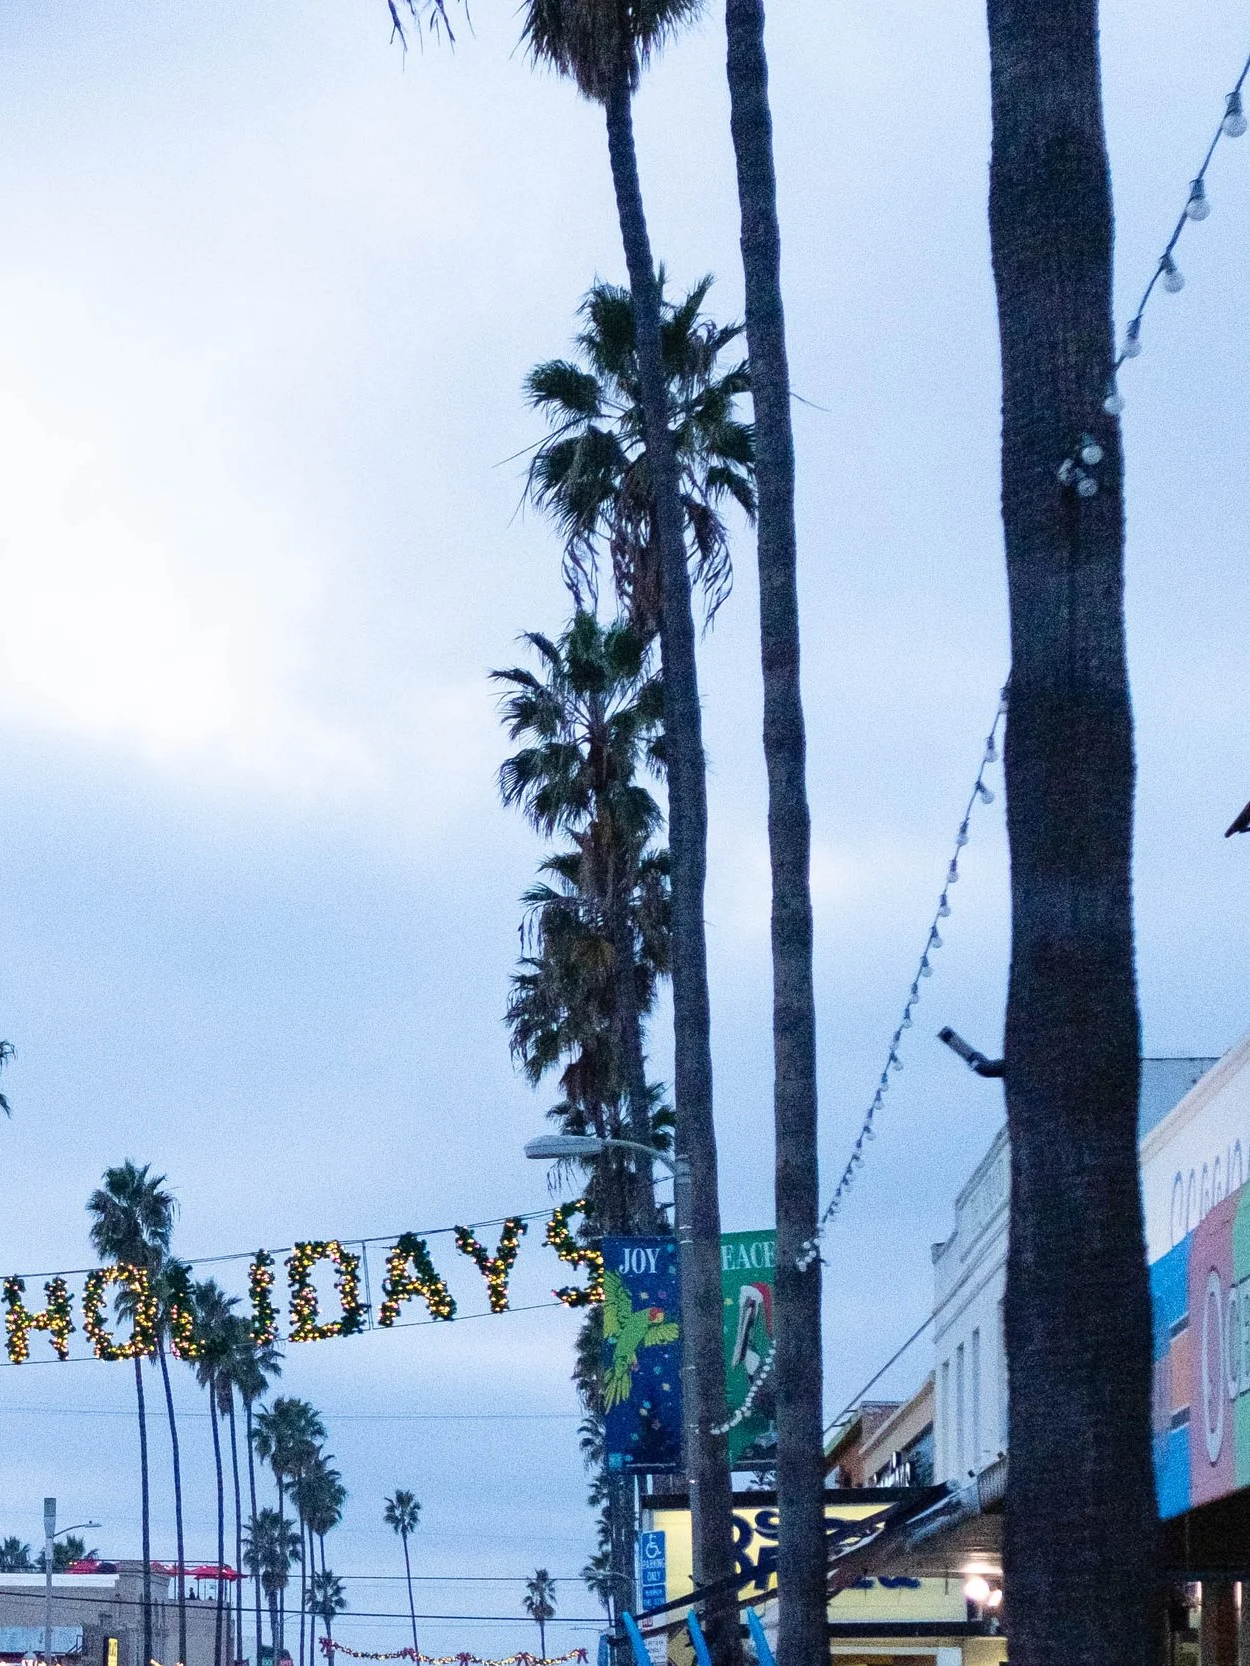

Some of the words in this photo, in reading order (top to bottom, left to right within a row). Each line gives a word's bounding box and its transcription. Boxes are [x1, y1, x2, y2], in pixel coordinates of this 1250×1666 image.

[619, 1248, 660, 1274] JOY
[721, 1241, 776, 1271] EACE
[2, 1200, 607, 1364] HOLIDAYS
